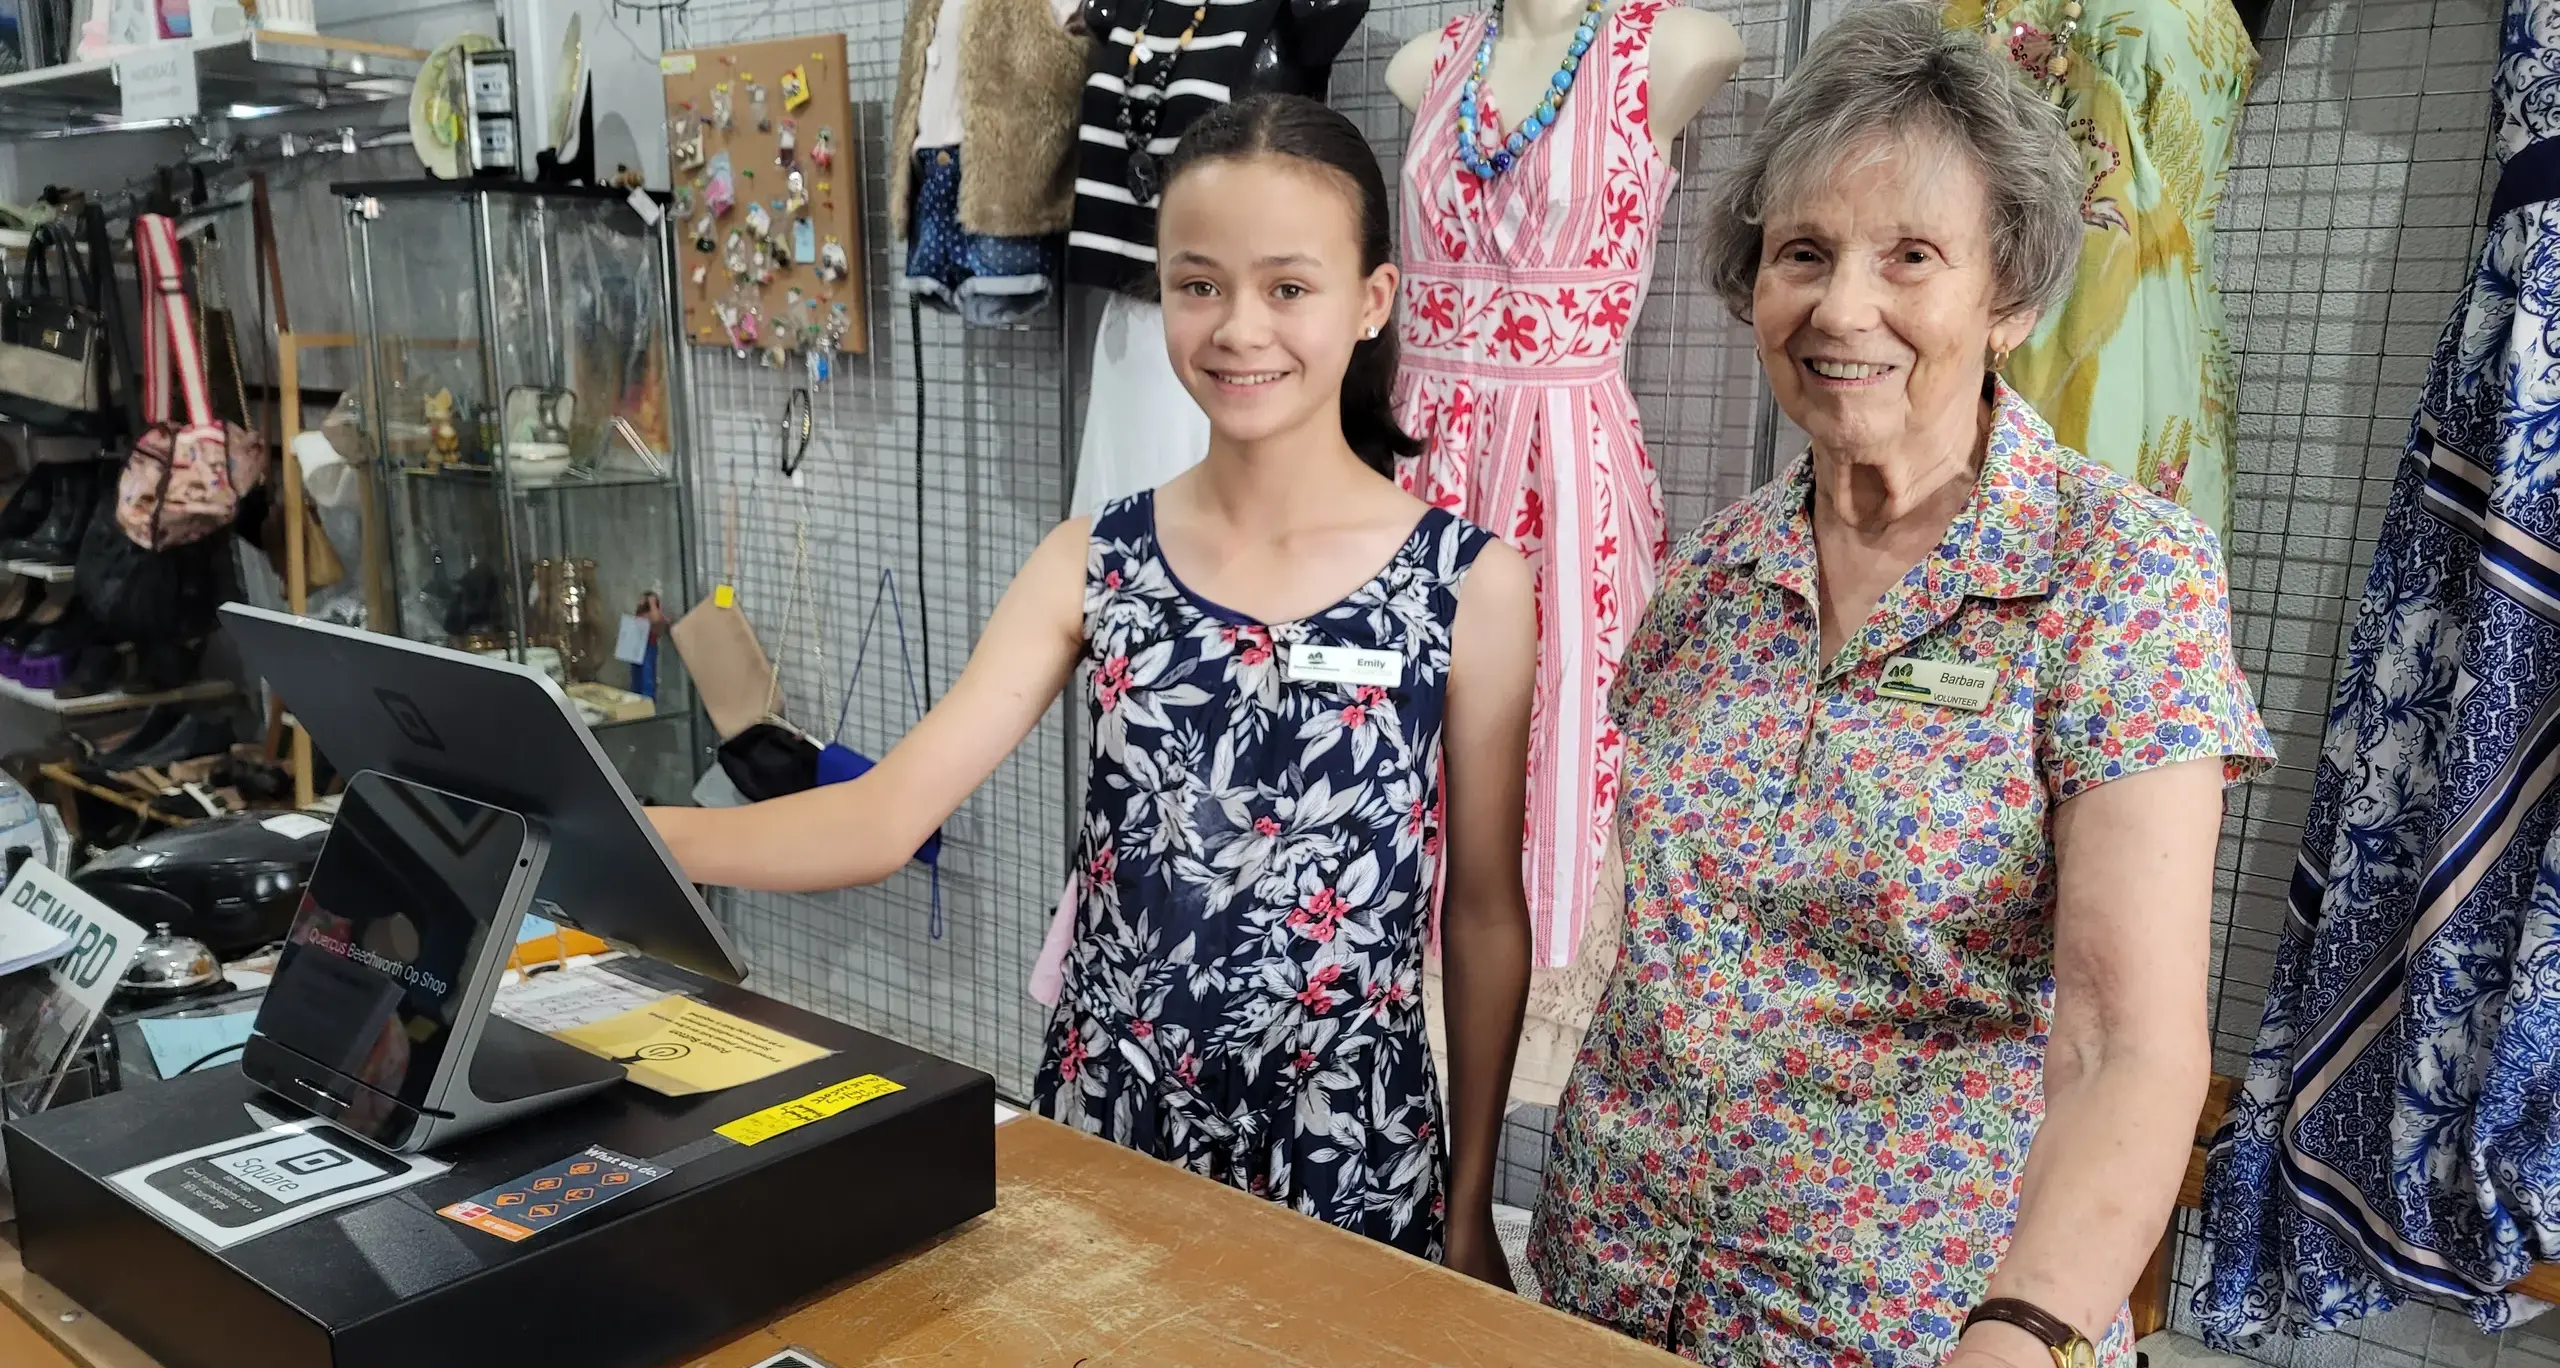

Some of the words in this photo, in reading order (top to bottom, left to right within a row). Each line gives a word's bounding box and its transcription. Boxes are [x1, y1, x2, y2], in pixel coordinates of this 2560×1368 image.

[1357, 658, 1386, 669] Emily
[1940, 672, 1985, 689] Barbara
[1934, 693, 1978, 707] VOLUNTEER
[308, 928, 347, 955] Quercus
[347, 942, 403, 977] Beechworth
[404, 965, 419, 986] Op
[420, 971, 447, 996] Shop
[668, 1029, 702, 1043] Button
[699, 1041, 732, 1054] Power
[584, 1147, 620, 1164] What
[619, 1160, 639, 1170] we
[232, 1158, 300, 1193] Square
